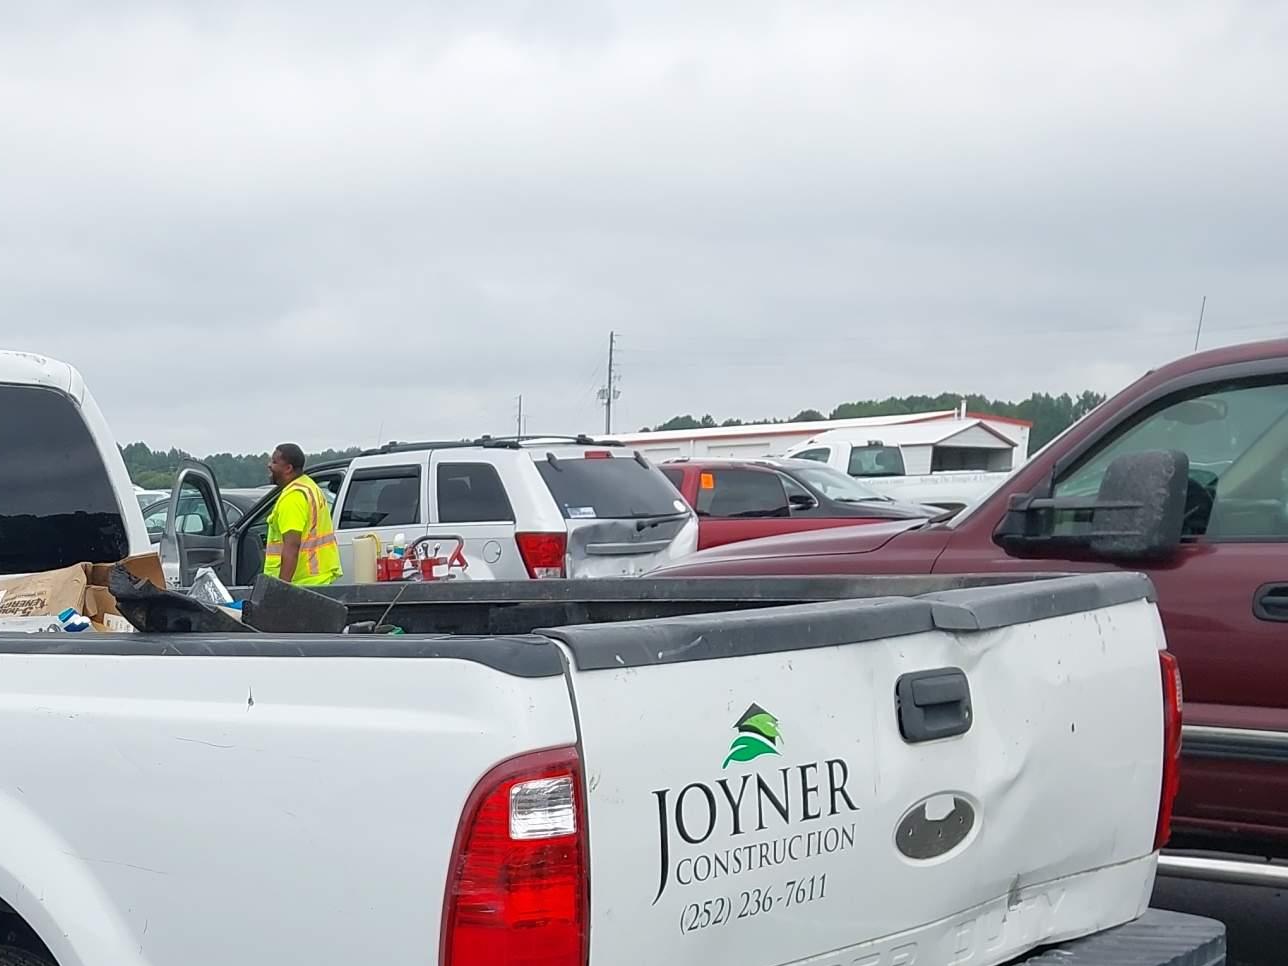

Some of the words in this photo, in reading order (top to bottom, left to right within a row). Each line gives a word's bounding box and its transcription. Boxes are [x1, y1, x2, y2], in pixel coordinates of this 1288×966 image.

[652, 758, 860, 906] JOYNER
[676, 824, 856, 885] CONSTRUCTION
[680, 896, 731, 935] (252)
[738, 873, 827, 919] 236-7611
